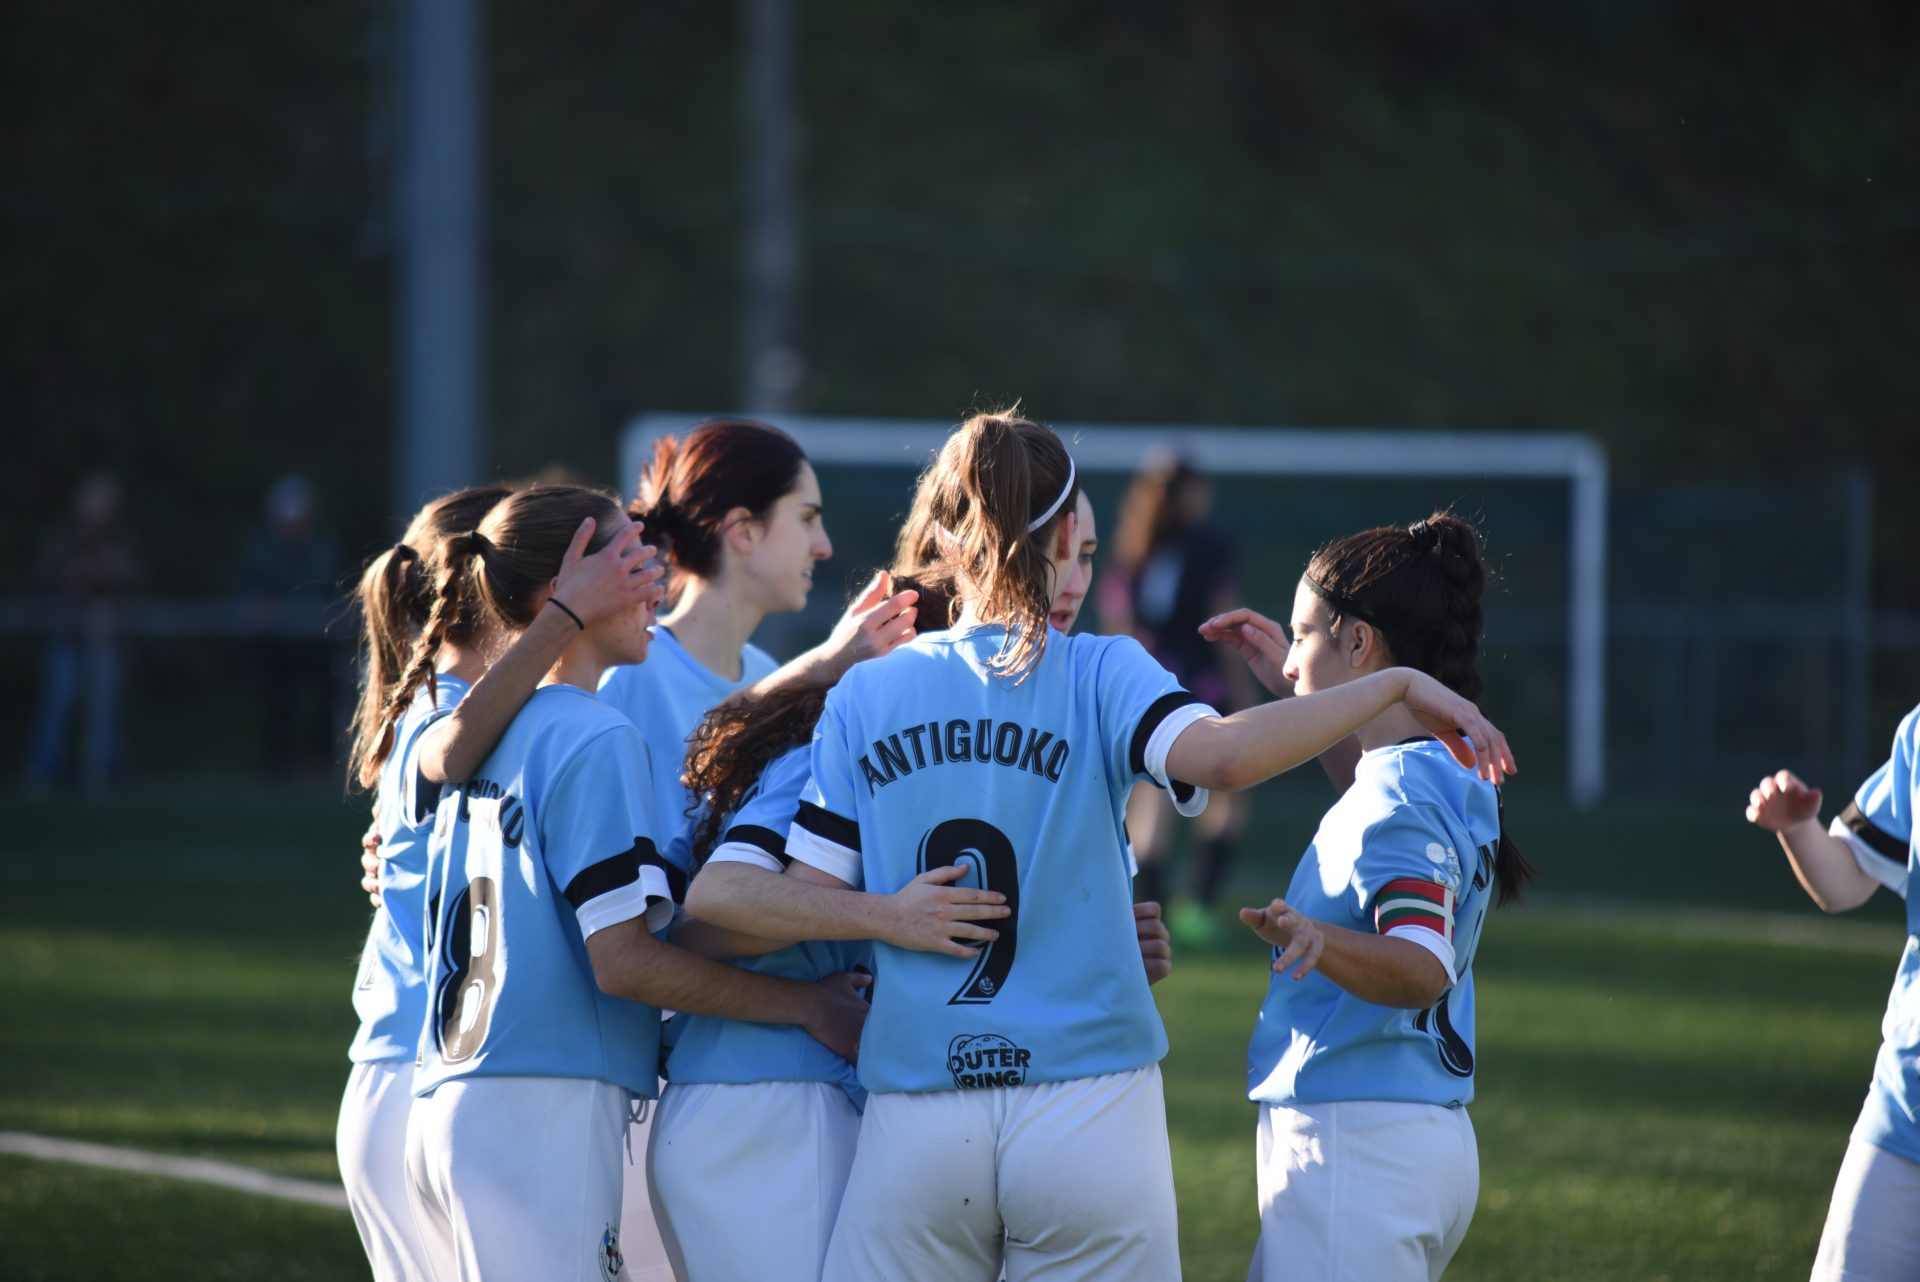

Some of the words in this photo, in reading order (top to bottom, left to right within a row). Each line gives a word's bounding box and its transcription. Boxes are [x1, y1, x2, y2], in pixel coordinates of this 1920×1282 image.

[859, 718, 1070, 799] ANTIGUOKO
[916, 818, 1020, 1005] 9
[951, 1048, 1031, 1074] OUTER
[960, 1069, 1021, 1088] RING
